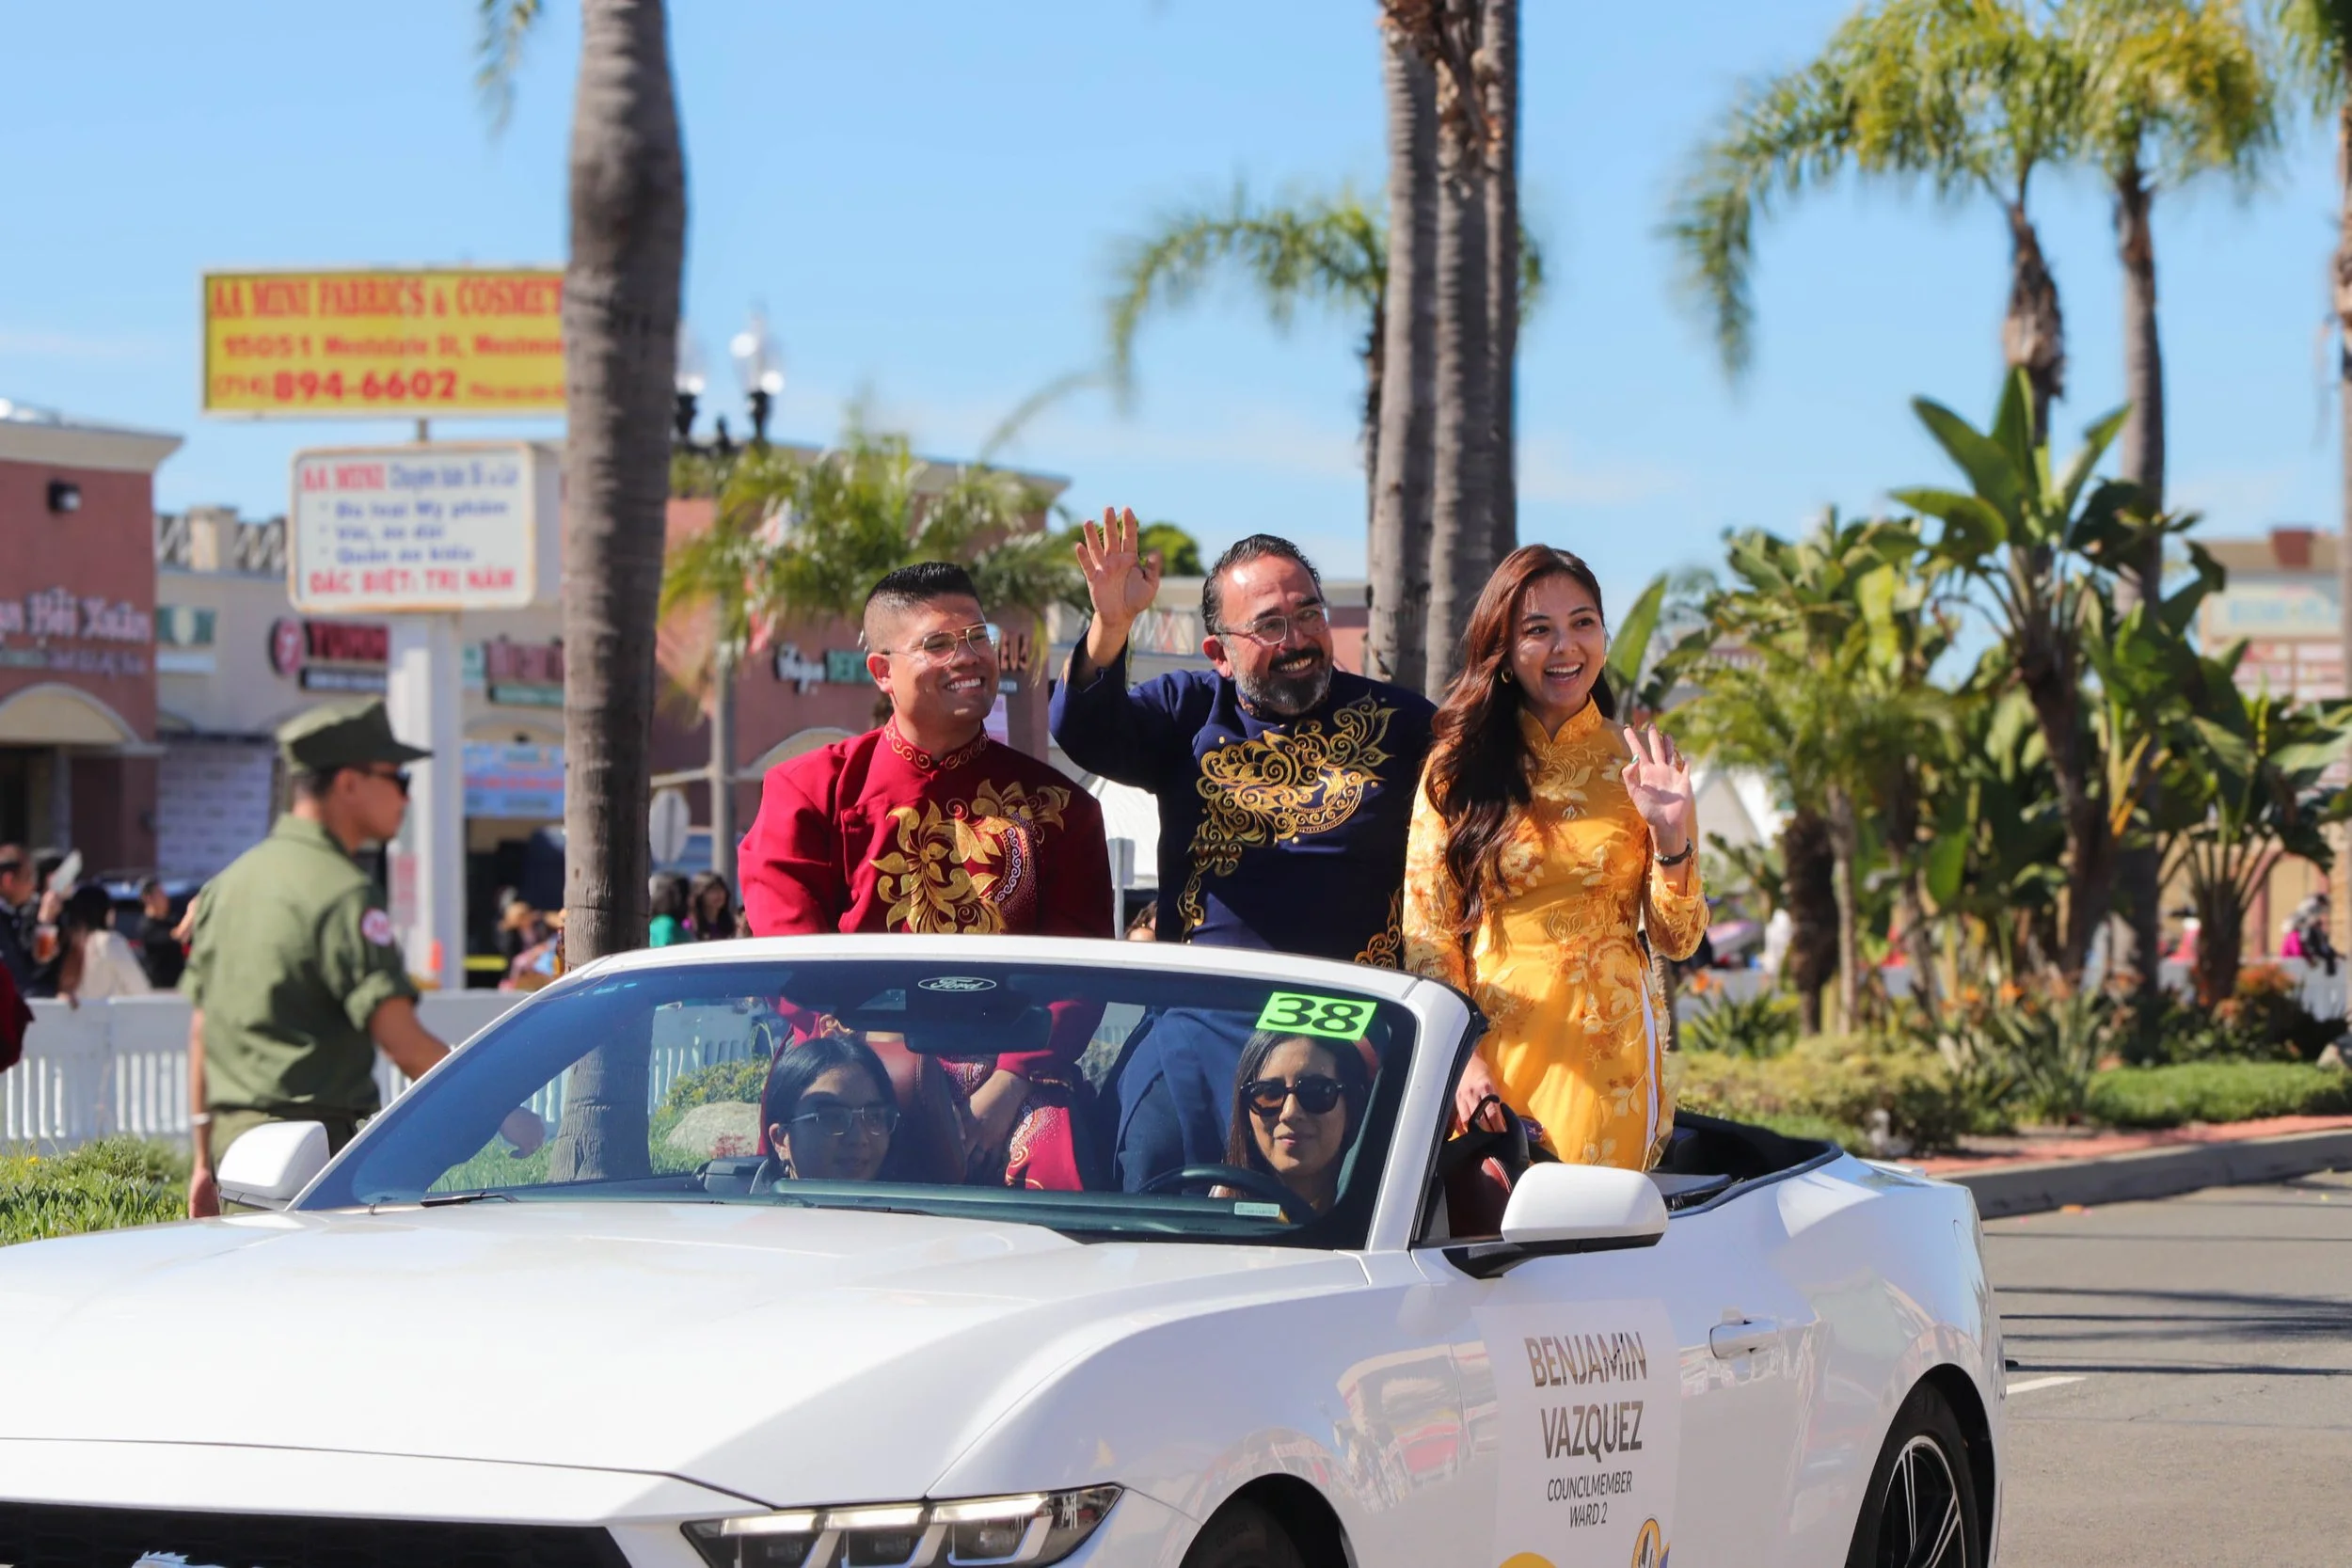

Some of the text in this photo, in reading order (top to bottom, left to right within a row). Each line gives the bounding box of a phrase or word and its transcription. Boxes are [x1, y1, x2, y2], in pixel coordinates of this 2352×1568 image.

[213, 279, 244, 318] AA
[251, 279, 310, 318] MINI
[318, 278, 426, 318] FABRICS
[274, 369, 458, 402] 894-6602
[303, 465, 328, 492] AA
[334, 463, 386, 491] MINI
[1265, 997, 1364, 1033] 38
[1524, 1331, 1647, 1387] BENJAMIN
[1541, 1402, 1644, 1463] VAZQUEZ
[1548, 1470, 1632, 1502] COUNCILMEMBER
[1569, 1501, 1608, 1528] WARD 2
